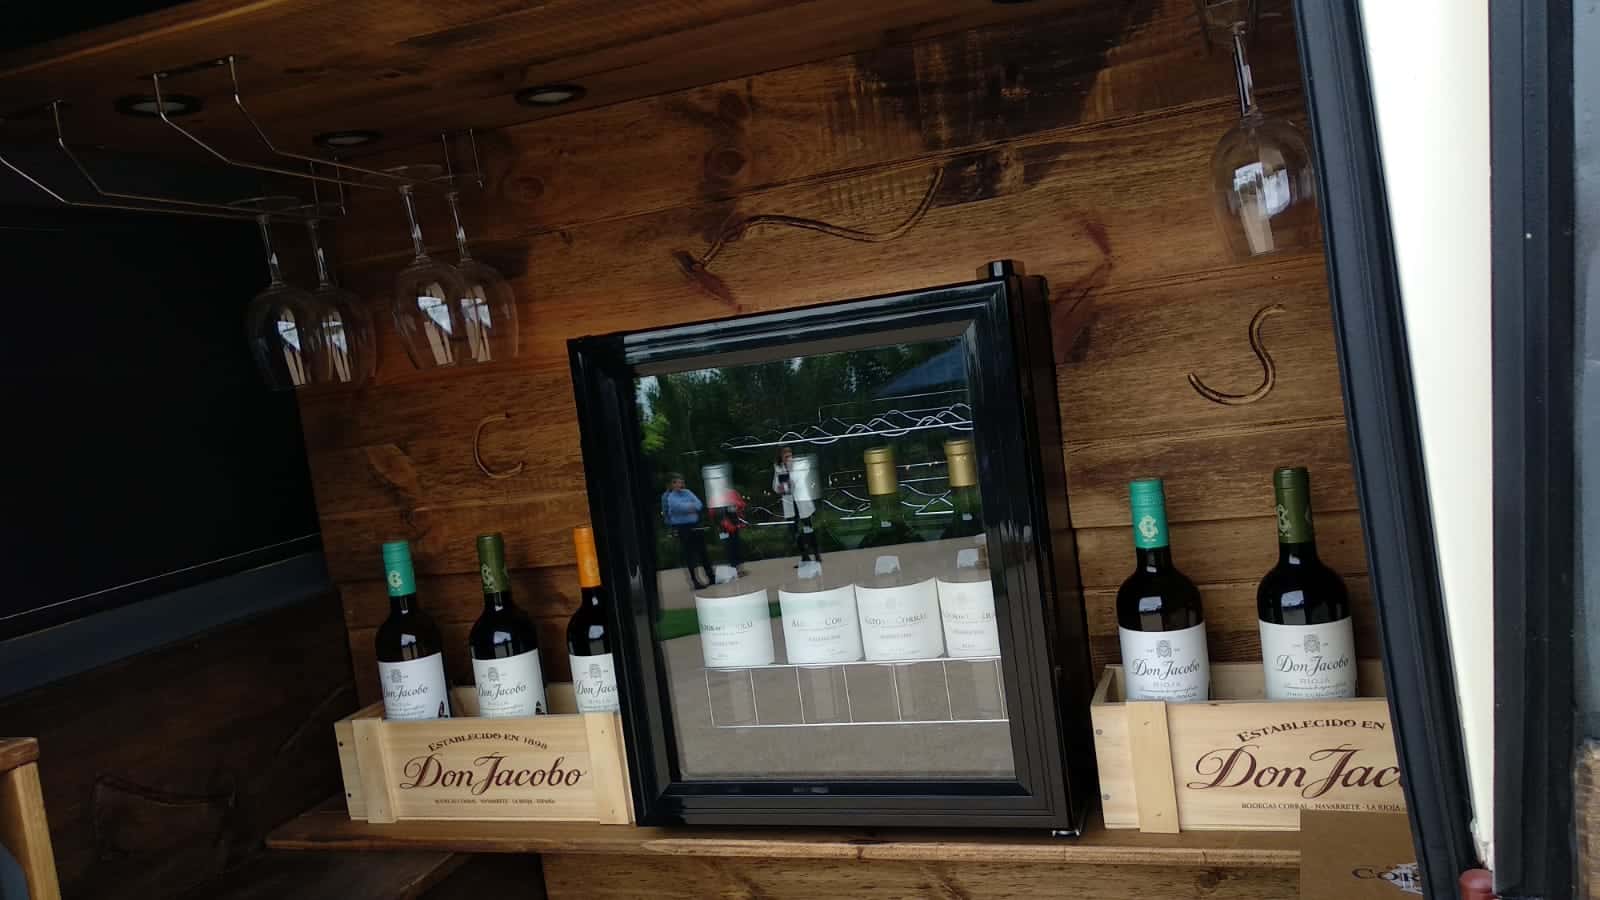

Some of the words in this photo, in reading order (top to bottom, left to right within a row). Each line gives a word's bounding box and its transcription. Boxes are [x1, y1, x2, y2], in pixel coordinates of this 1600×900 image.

[1131, 658, 1161, 677] Don
[1158, 658, 1200, 681] Jacobo
[1272, 654, 1309, 673] Don
[1306, 653, 1349, 677] Jacobo
[391, 683, 429, 702] Jacobo
[489, 681, 527, 701] Jacobo
[1237, 718, 1357, 742] ESTABLECIDO
[1361, 720, 1386, 731] EN
[428, 732, 502, 752] ESTABLECIDO
[504, 732, 520, 742] EN
[400, 753, 474, 790] Don
[471, 751, 587, 796] Jacobo
[1186, 744, 1306, 790] Don
